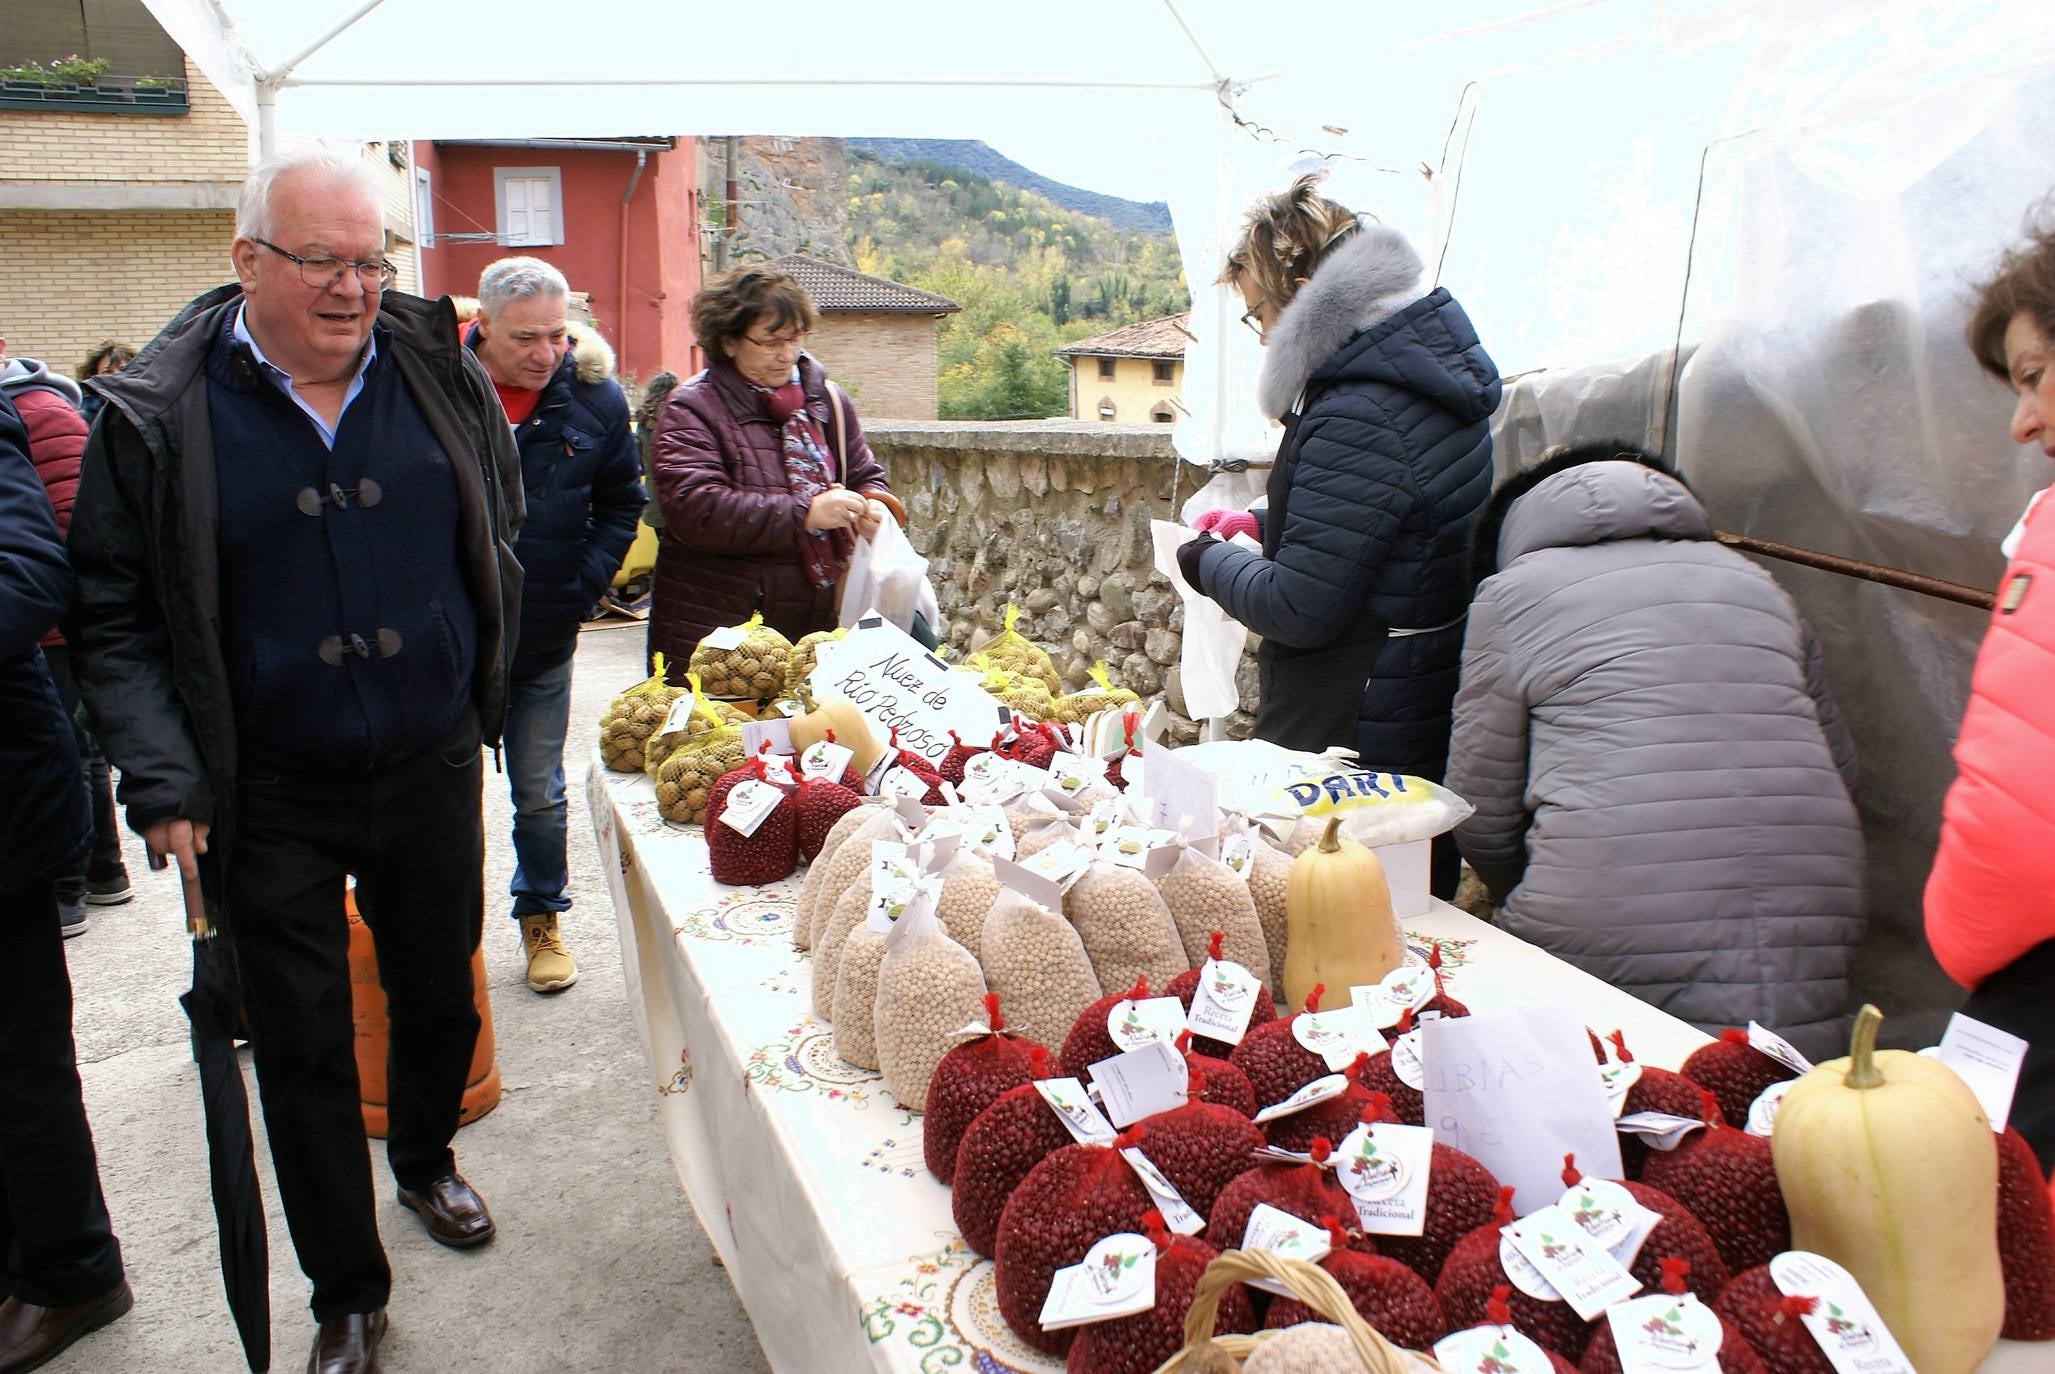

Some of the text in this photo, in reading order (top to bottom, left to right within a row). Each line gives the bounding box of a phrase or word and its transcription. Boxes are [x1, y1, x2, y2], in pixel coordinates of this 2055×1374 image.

[869, 652, 950, 711] Nuez de
[865, 695, 951, 758] Pedroso
[1194, 1014, 1239, 1033] Tradicional
[1357, 1205, 1415, 1220] Tradicional
